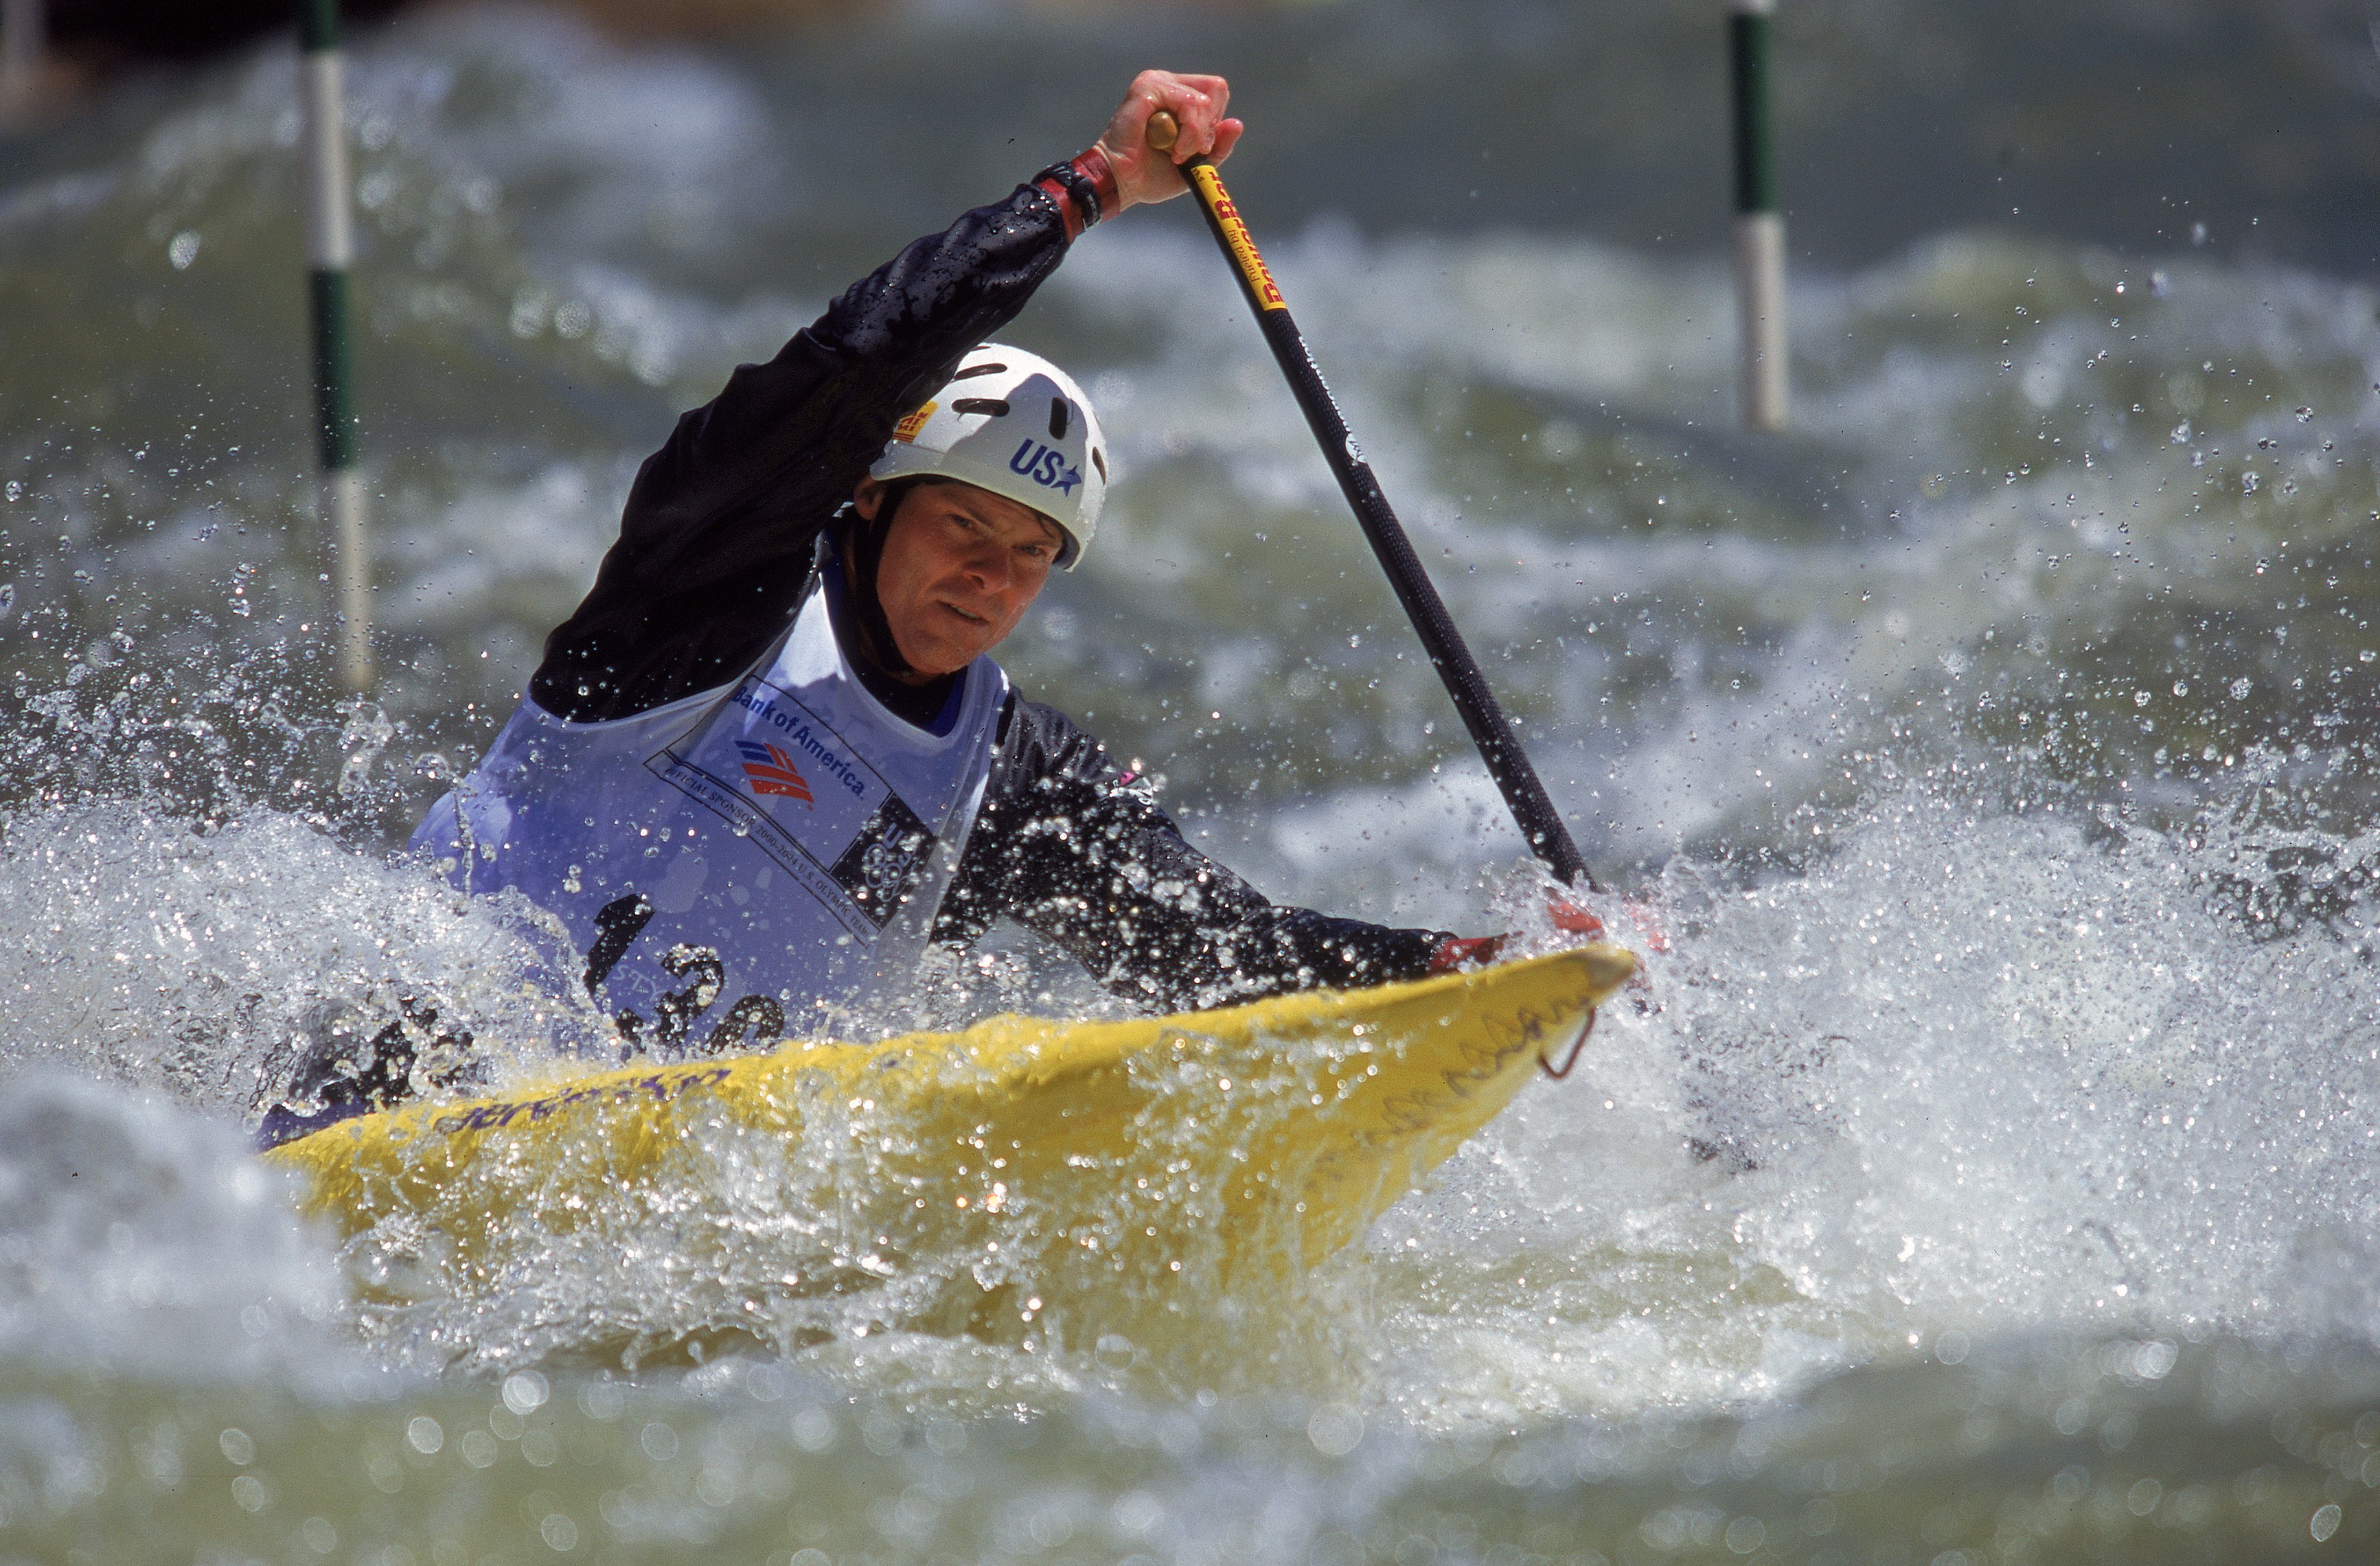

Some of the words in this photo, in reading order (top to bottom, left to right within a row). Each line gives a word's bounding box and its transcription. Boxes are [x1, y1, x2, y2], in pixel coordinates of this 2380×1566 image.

[1227, 229, 1239, 246] by
[1237, 245, 1260, 282] Fueled
[733, 687, 776, 720] Bank
[774, 713, 800, 733] of
[709, 792, 755, 829] SPONSOR
[755, 825, 797, 865] 2000-2004
[797, 863, 814, 884] U.S.
[815, 880, 851, 916] OLYMPIC
